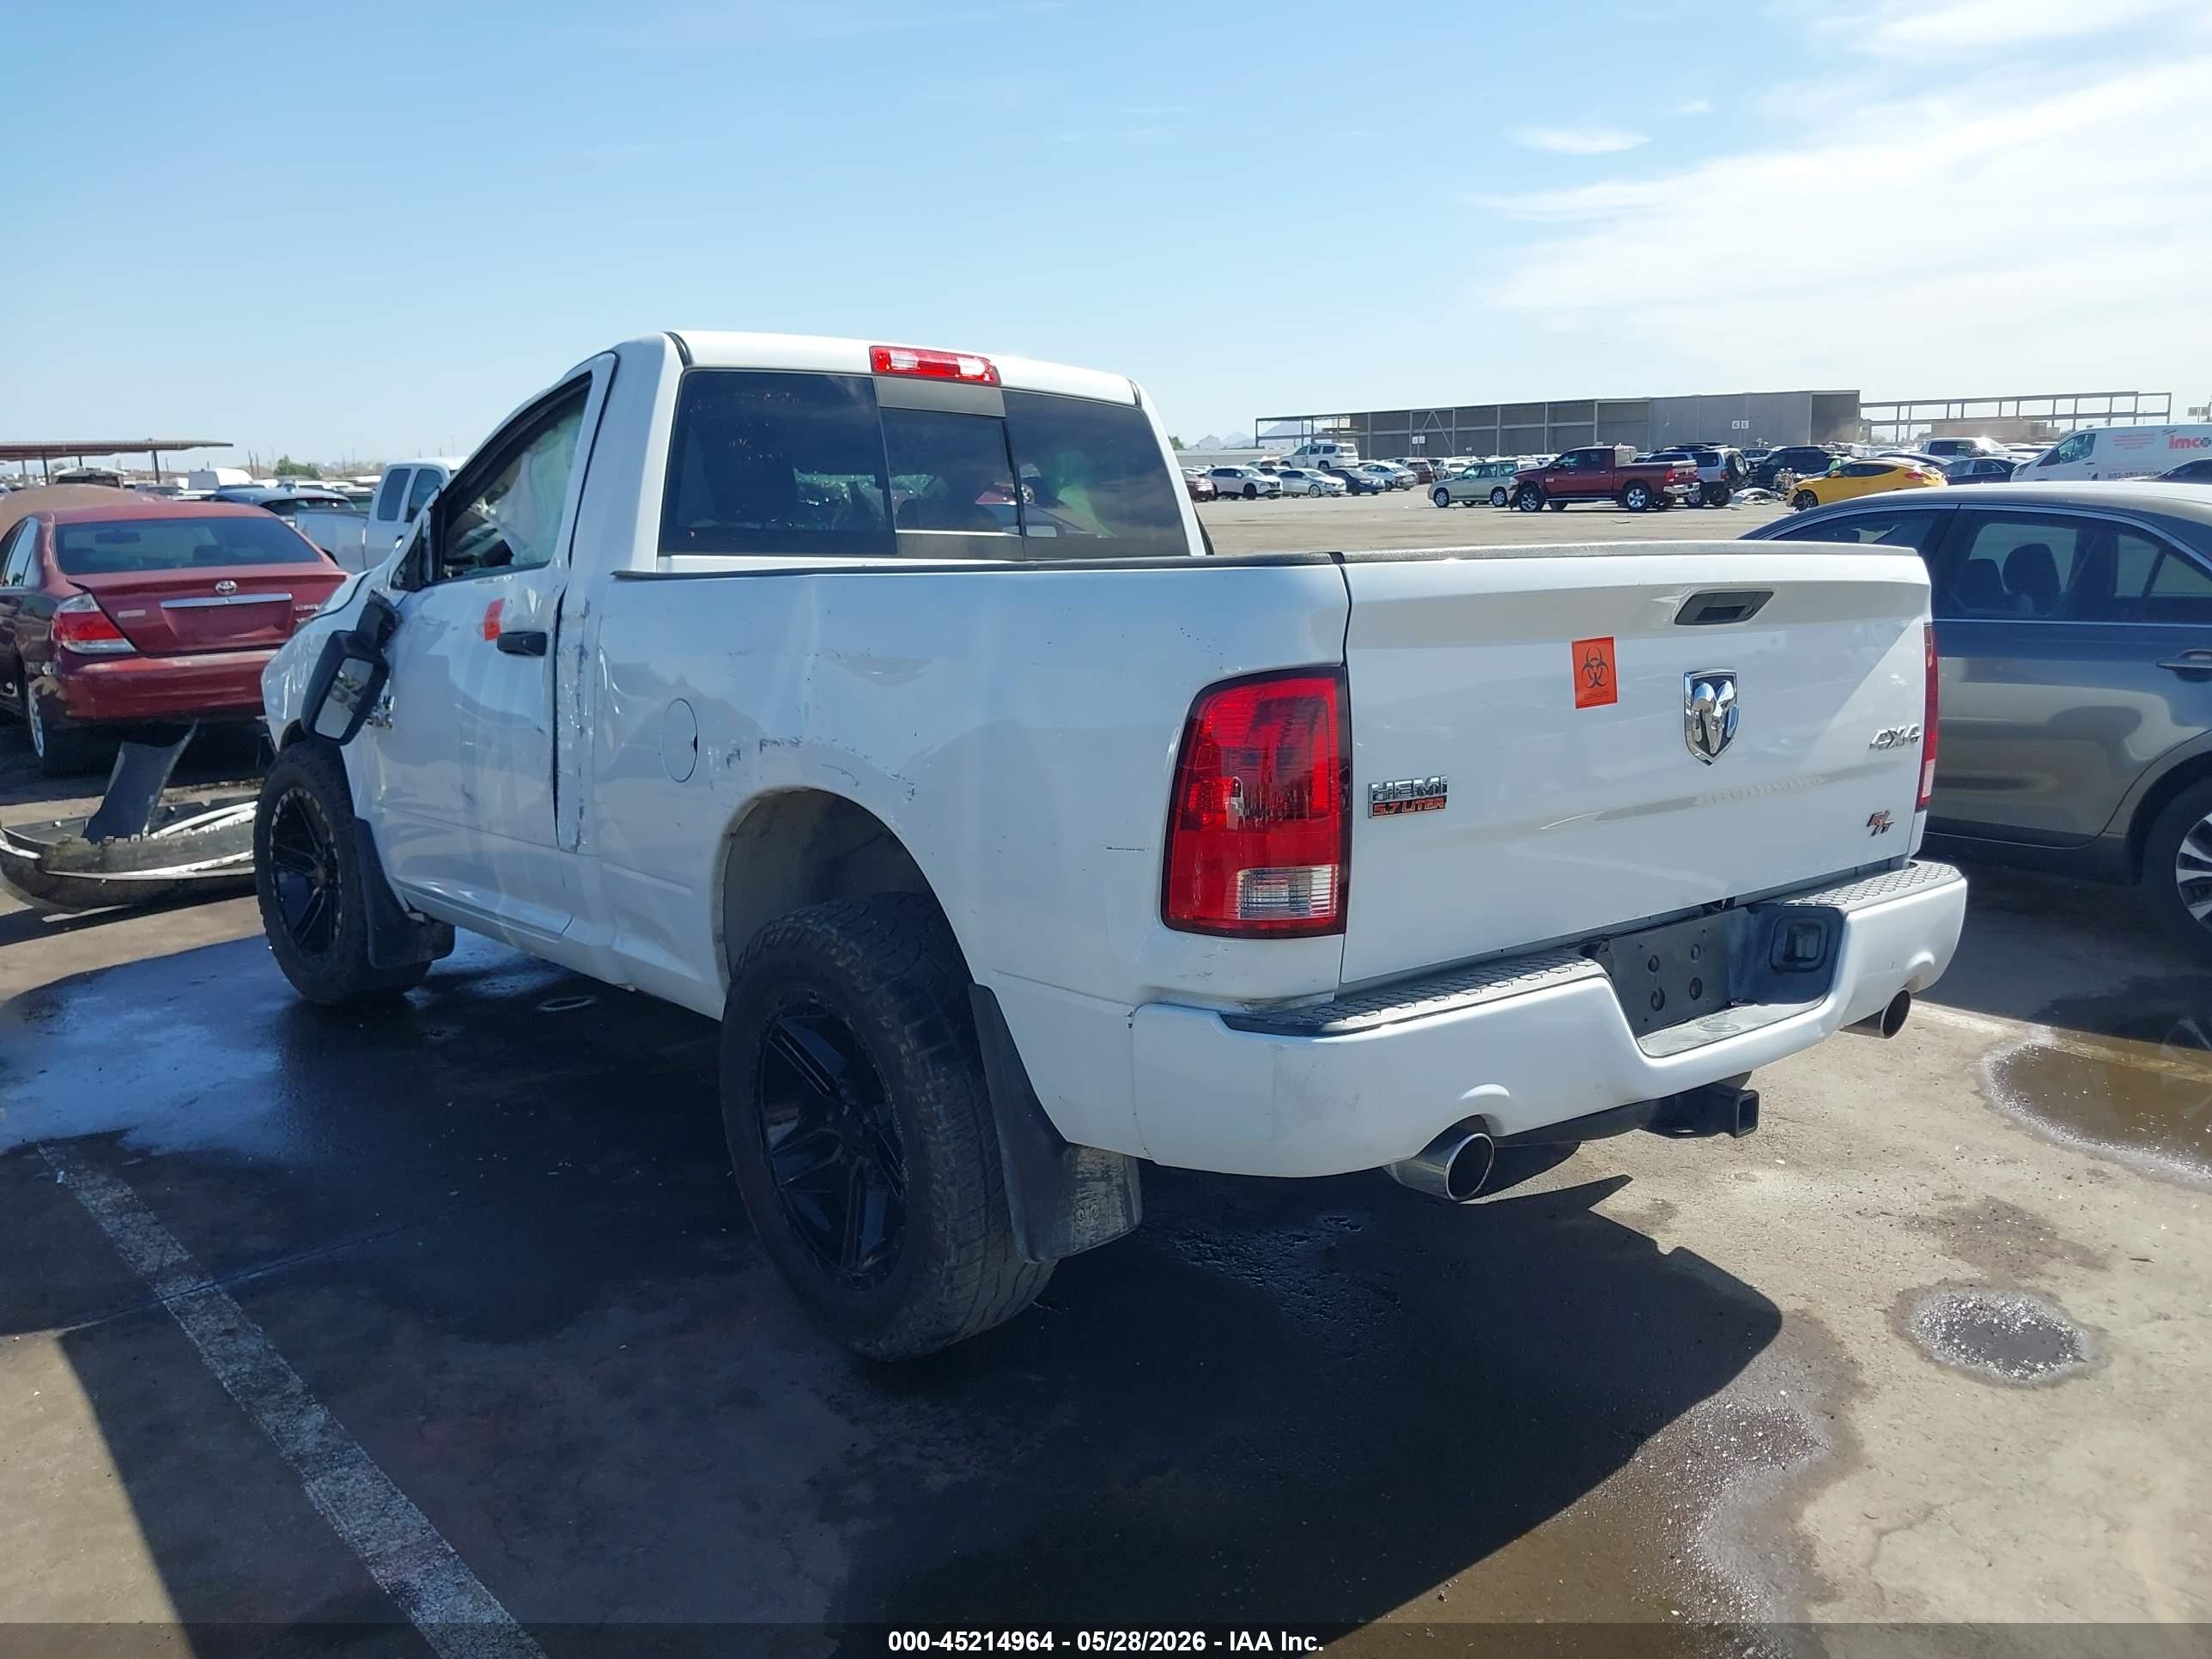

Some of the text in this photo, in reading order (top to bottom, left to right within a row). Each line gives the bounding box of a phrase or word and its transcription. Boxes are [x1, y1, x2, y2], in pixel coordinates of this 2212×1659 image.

[1369, 775, 1448, 802] HEMI
[1374, 796, 1445, 816] 5.7 LITER
